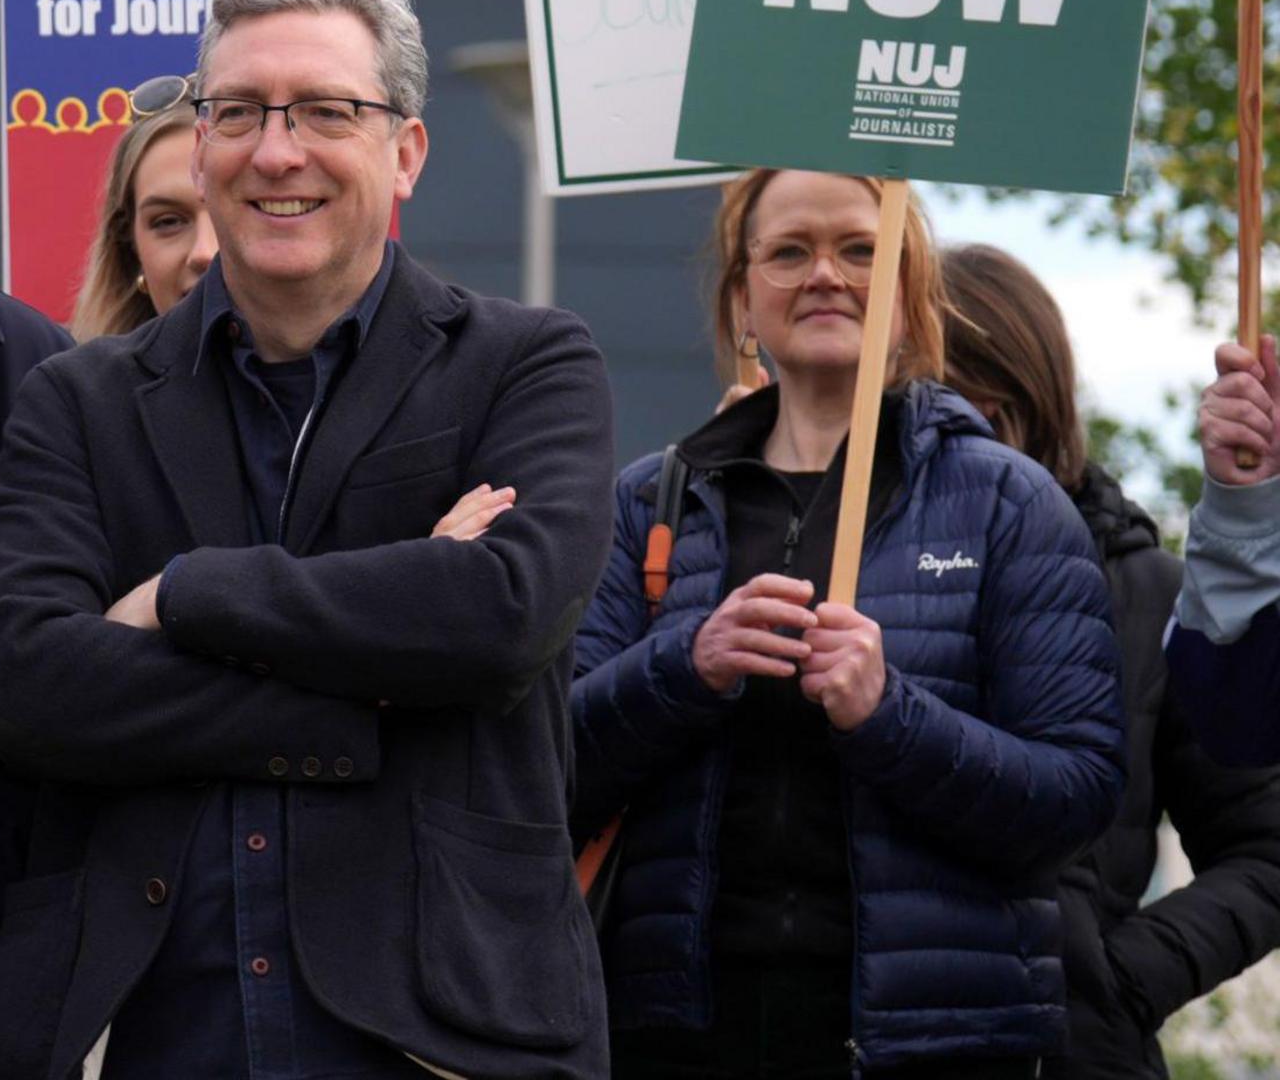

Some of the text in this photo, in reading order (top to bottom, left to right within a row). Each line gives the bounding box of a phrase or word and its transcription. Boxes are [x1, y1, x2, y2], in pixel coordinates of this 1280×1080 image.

[857, 39, 966, 88] NUJ
[854, 89, 960, 108] NATIONAL UNION
[849, 117, 956, 138] JOURNALISTS
